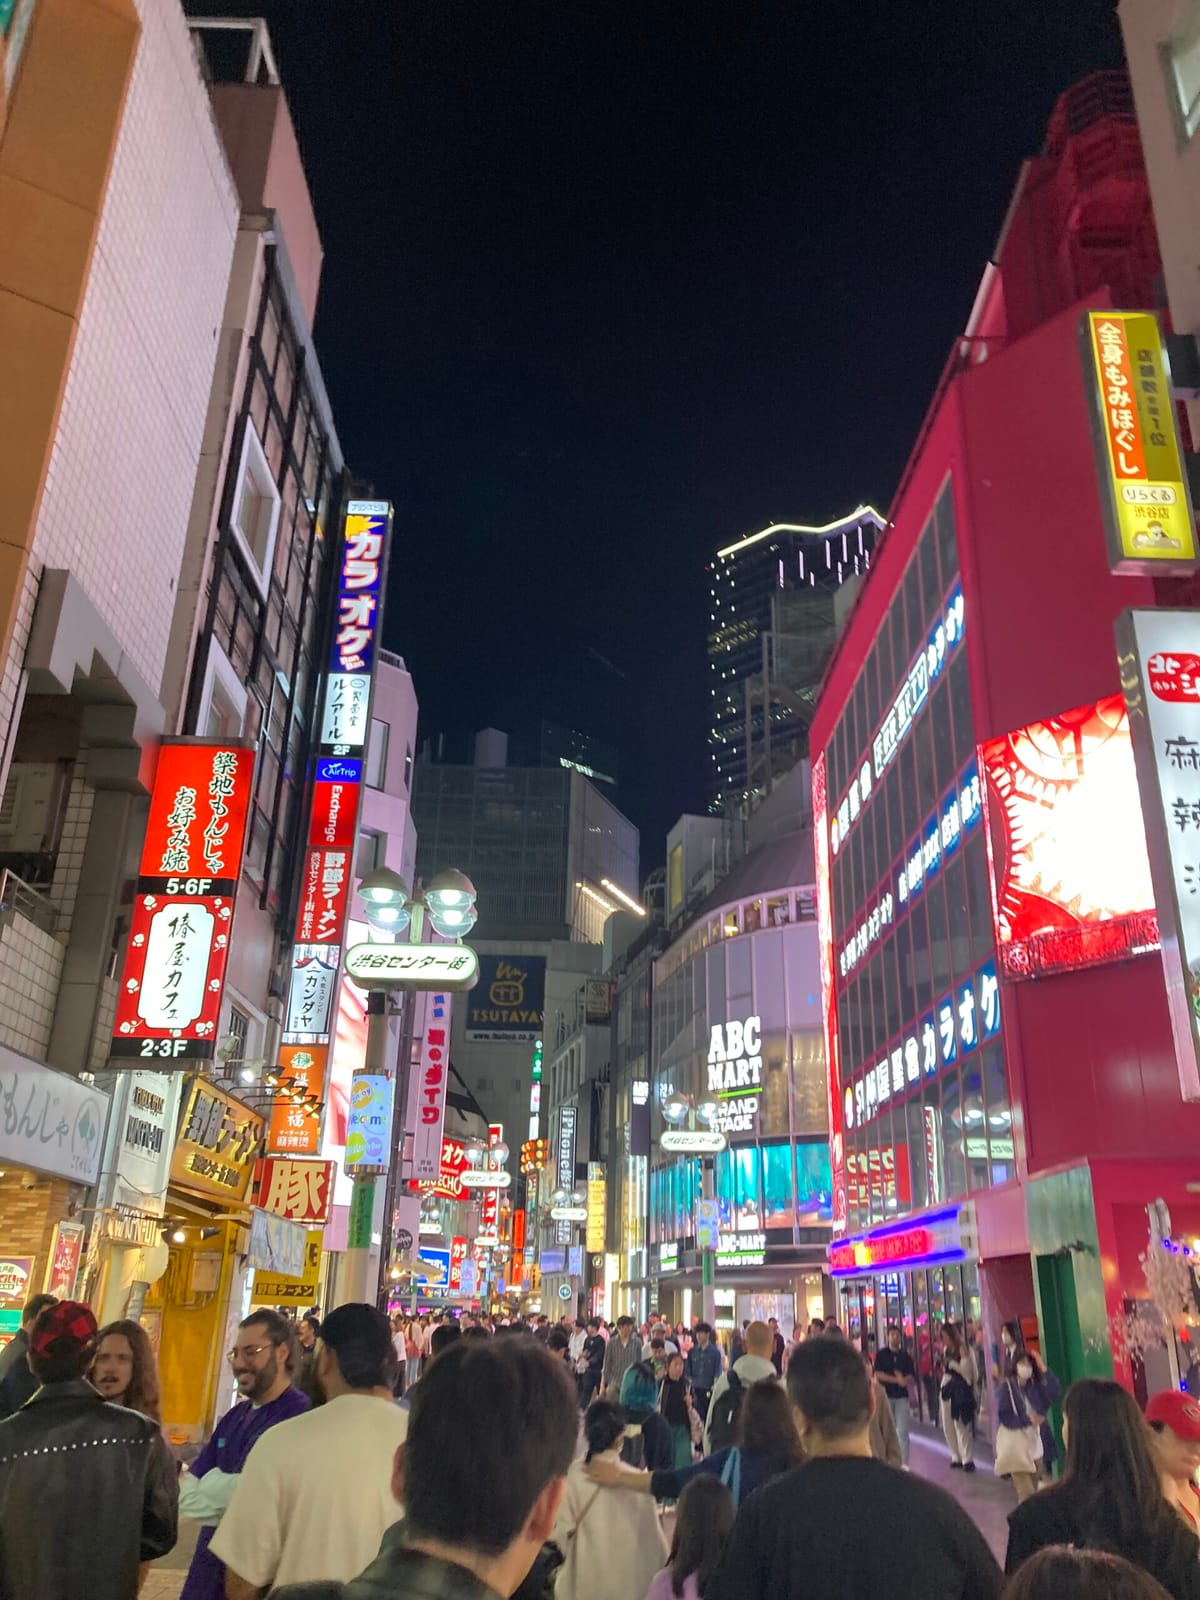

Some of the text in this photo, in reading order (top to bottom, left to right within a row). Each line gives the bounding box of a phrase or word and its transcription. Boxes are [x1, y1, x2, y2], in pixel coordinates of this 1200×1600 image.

[1097, 321, 1140, 475] 全身もみほぐし
[1126, 488, 1171, 501] りらくる
[1134, 506, 1170, 519] 渋谷店
[336, 531, 384, 656] カラオケ
[328, 678, 348, 740] ルノアール
[328, 766, 357, 778] AirTrip
[333, 745, 351, 755] 2F
[160, 787, 196, 873] お好み焼
[202, 751, 237, 874] 築地もんじゃ
[324, 785, 343, 842] Exchange
[316, 852, 346, 940] 野郎ラーメン
[159, 912, 197, 1020] 椿屋カフェ
[352, 953, 470, 971] 渋谷センター街
[300, 975, 318, 1028] カンダヤ
[472, 1008, 540, 1023] TSUTAYA
[707, 1016, 762, 1063] ABC
[707, 1056, 763, 1091] MART
[719, 1097, 758, 1117] RAND
[265, 1159, 326, 1218] 豚
[257, 1284, 314, 1297] 野郎ラーメン
